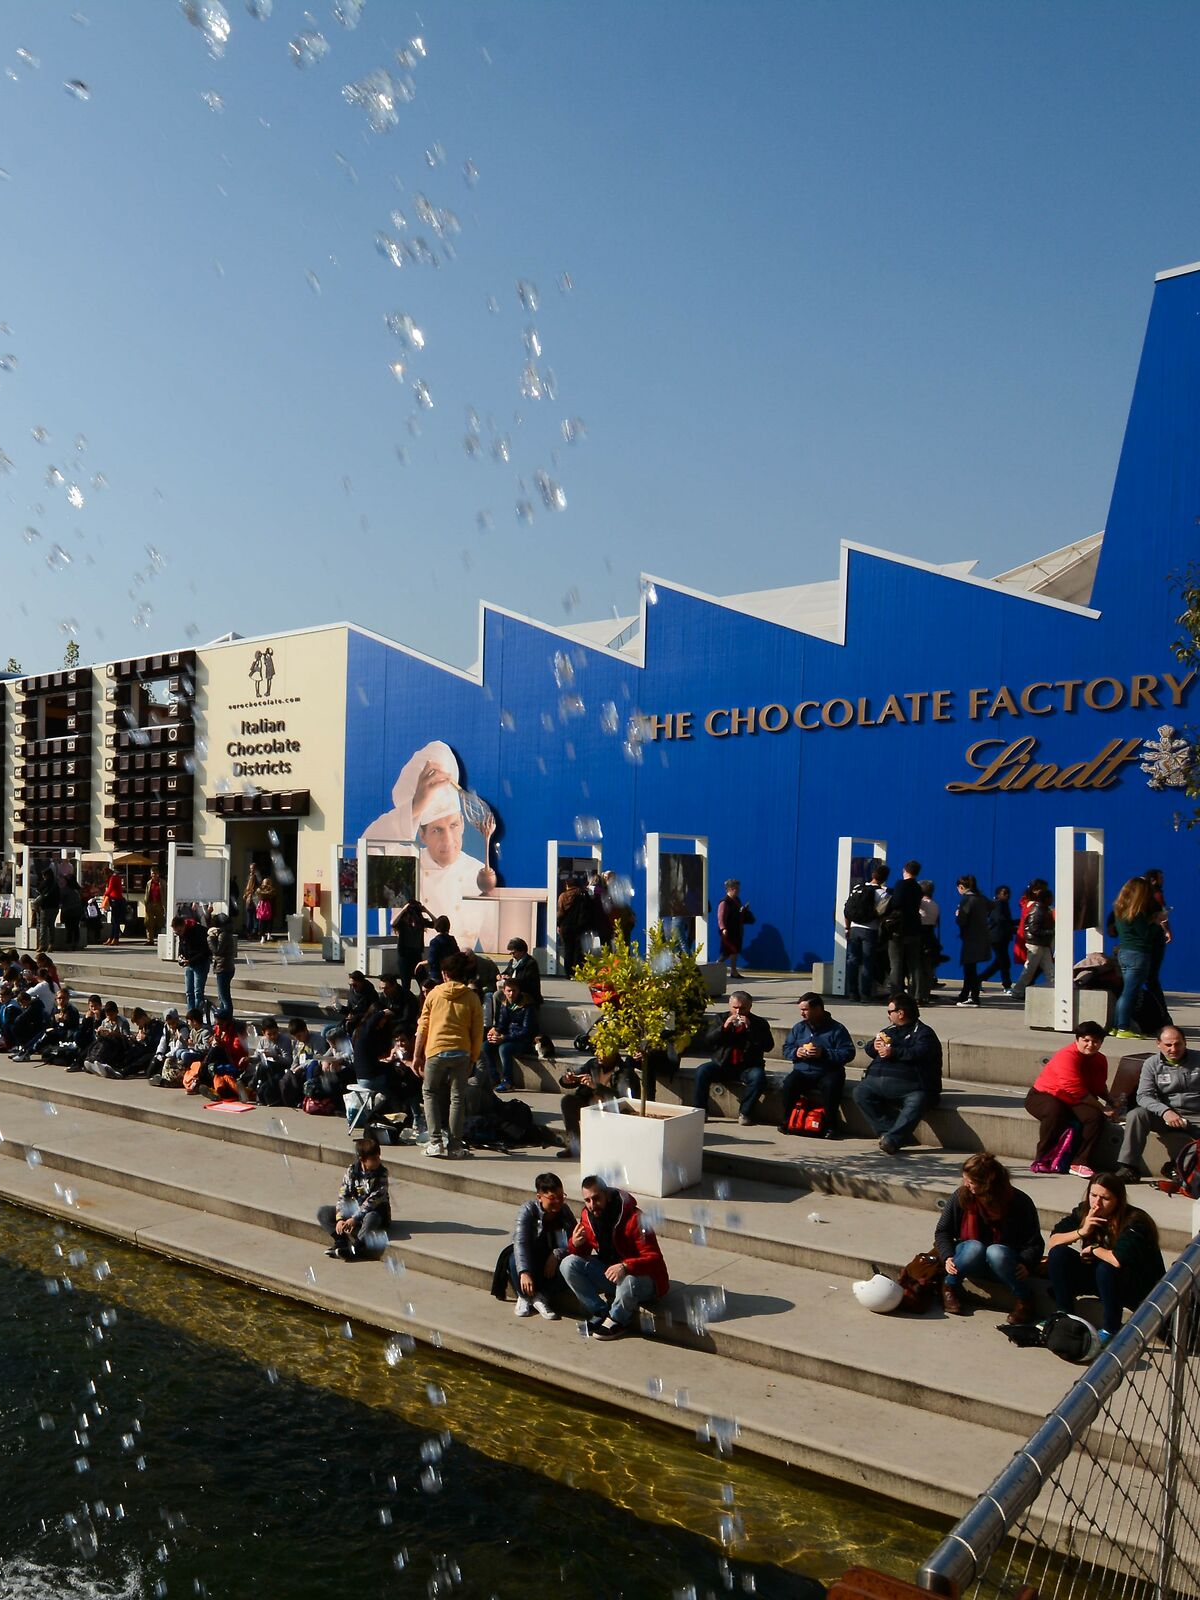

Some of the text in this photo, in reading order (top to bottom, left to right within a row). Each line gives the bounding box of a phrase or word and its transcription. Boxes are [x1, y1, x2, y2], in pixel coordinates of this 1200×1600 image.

[67, 672, 76, 796] UMBRIA
[106, 664, 115, 792] TORINO
[241, 719, 286, 735] Italian
[704, 690, 950, 737] CHOCOLATE
[968, 671, 1196, 719] FACTORY
[14, 681, 23, 820] PERUGIA
[167, 653, 179, 839] PIEMONTE
[227, 739, 301, 757] Chocolate
[233, 760, 292, 777] Districts
[945, 736, 1143, 792] Lindt
